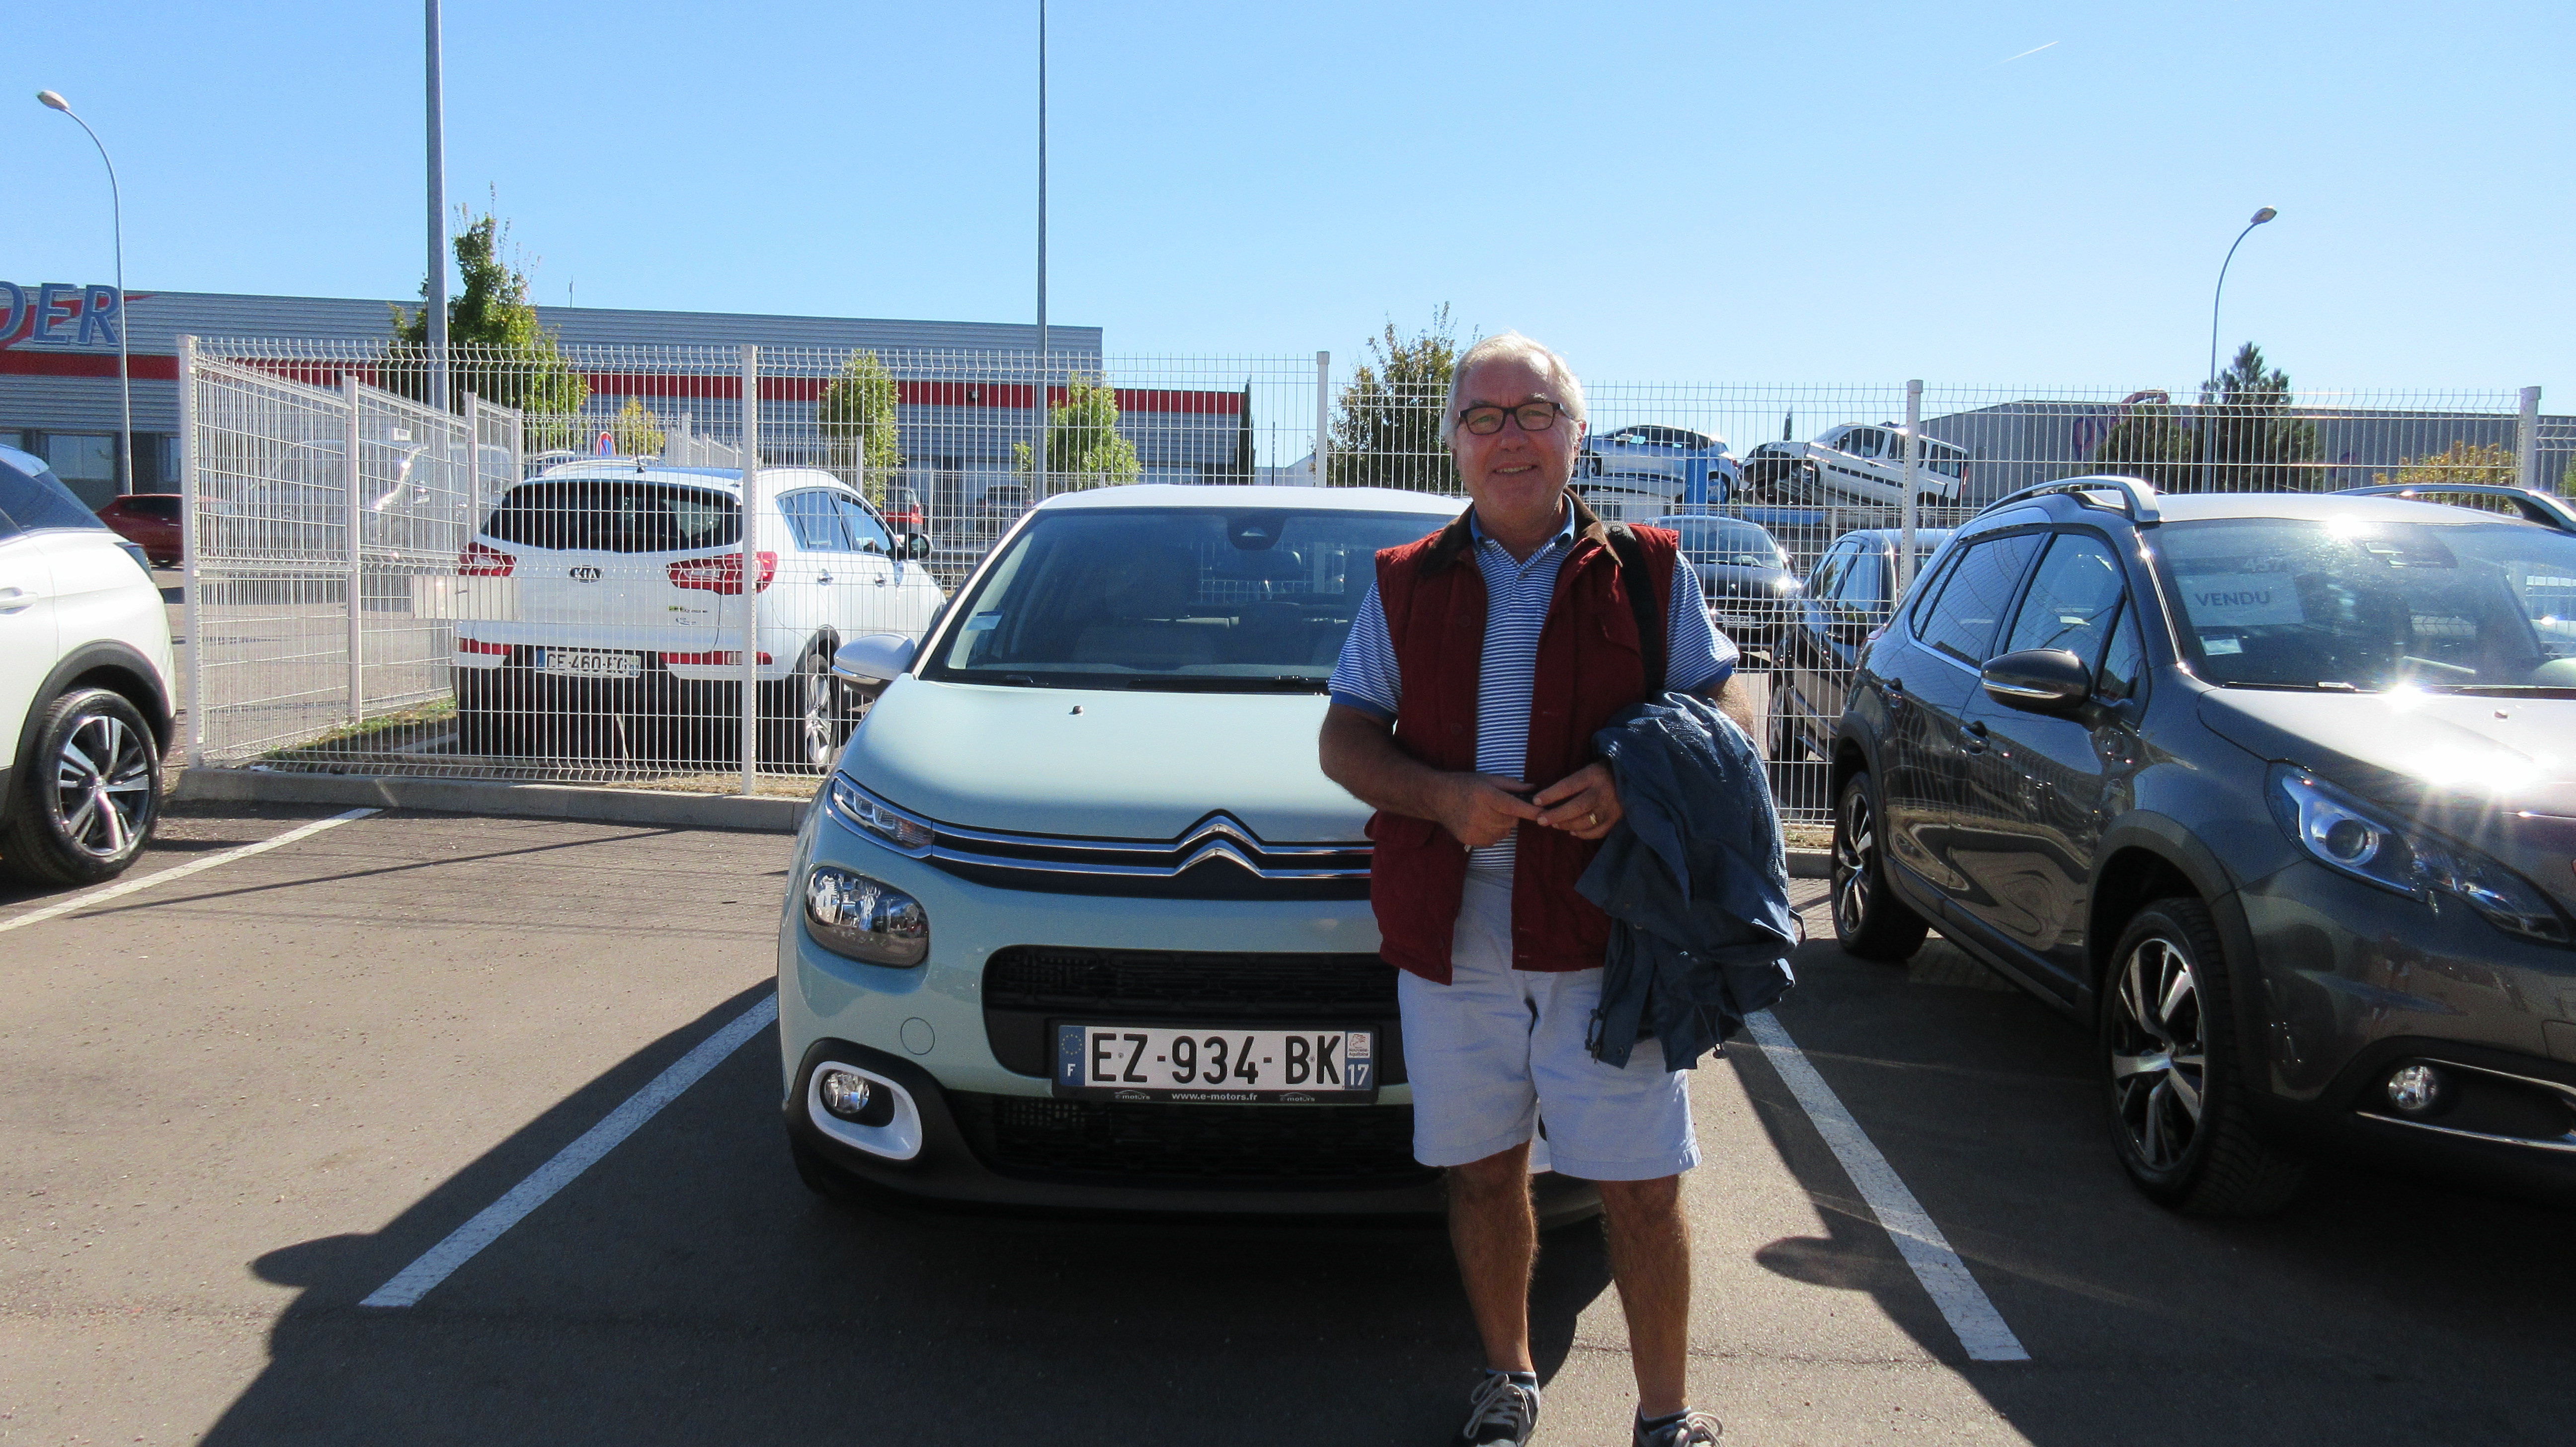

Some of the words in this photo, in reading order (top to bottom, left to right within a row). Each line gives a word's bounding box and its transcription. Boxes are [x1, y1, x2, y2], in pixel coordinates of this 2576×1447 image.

[574, 568, 598, 579] KIA
[2194, 590, 2270, 606] VENDU
[1092, 1033, 1341, 1085] EZ-934-BK
[1067, 1063, 1076, 1077] F
[1348, 1064, 1369, 1086] 17
